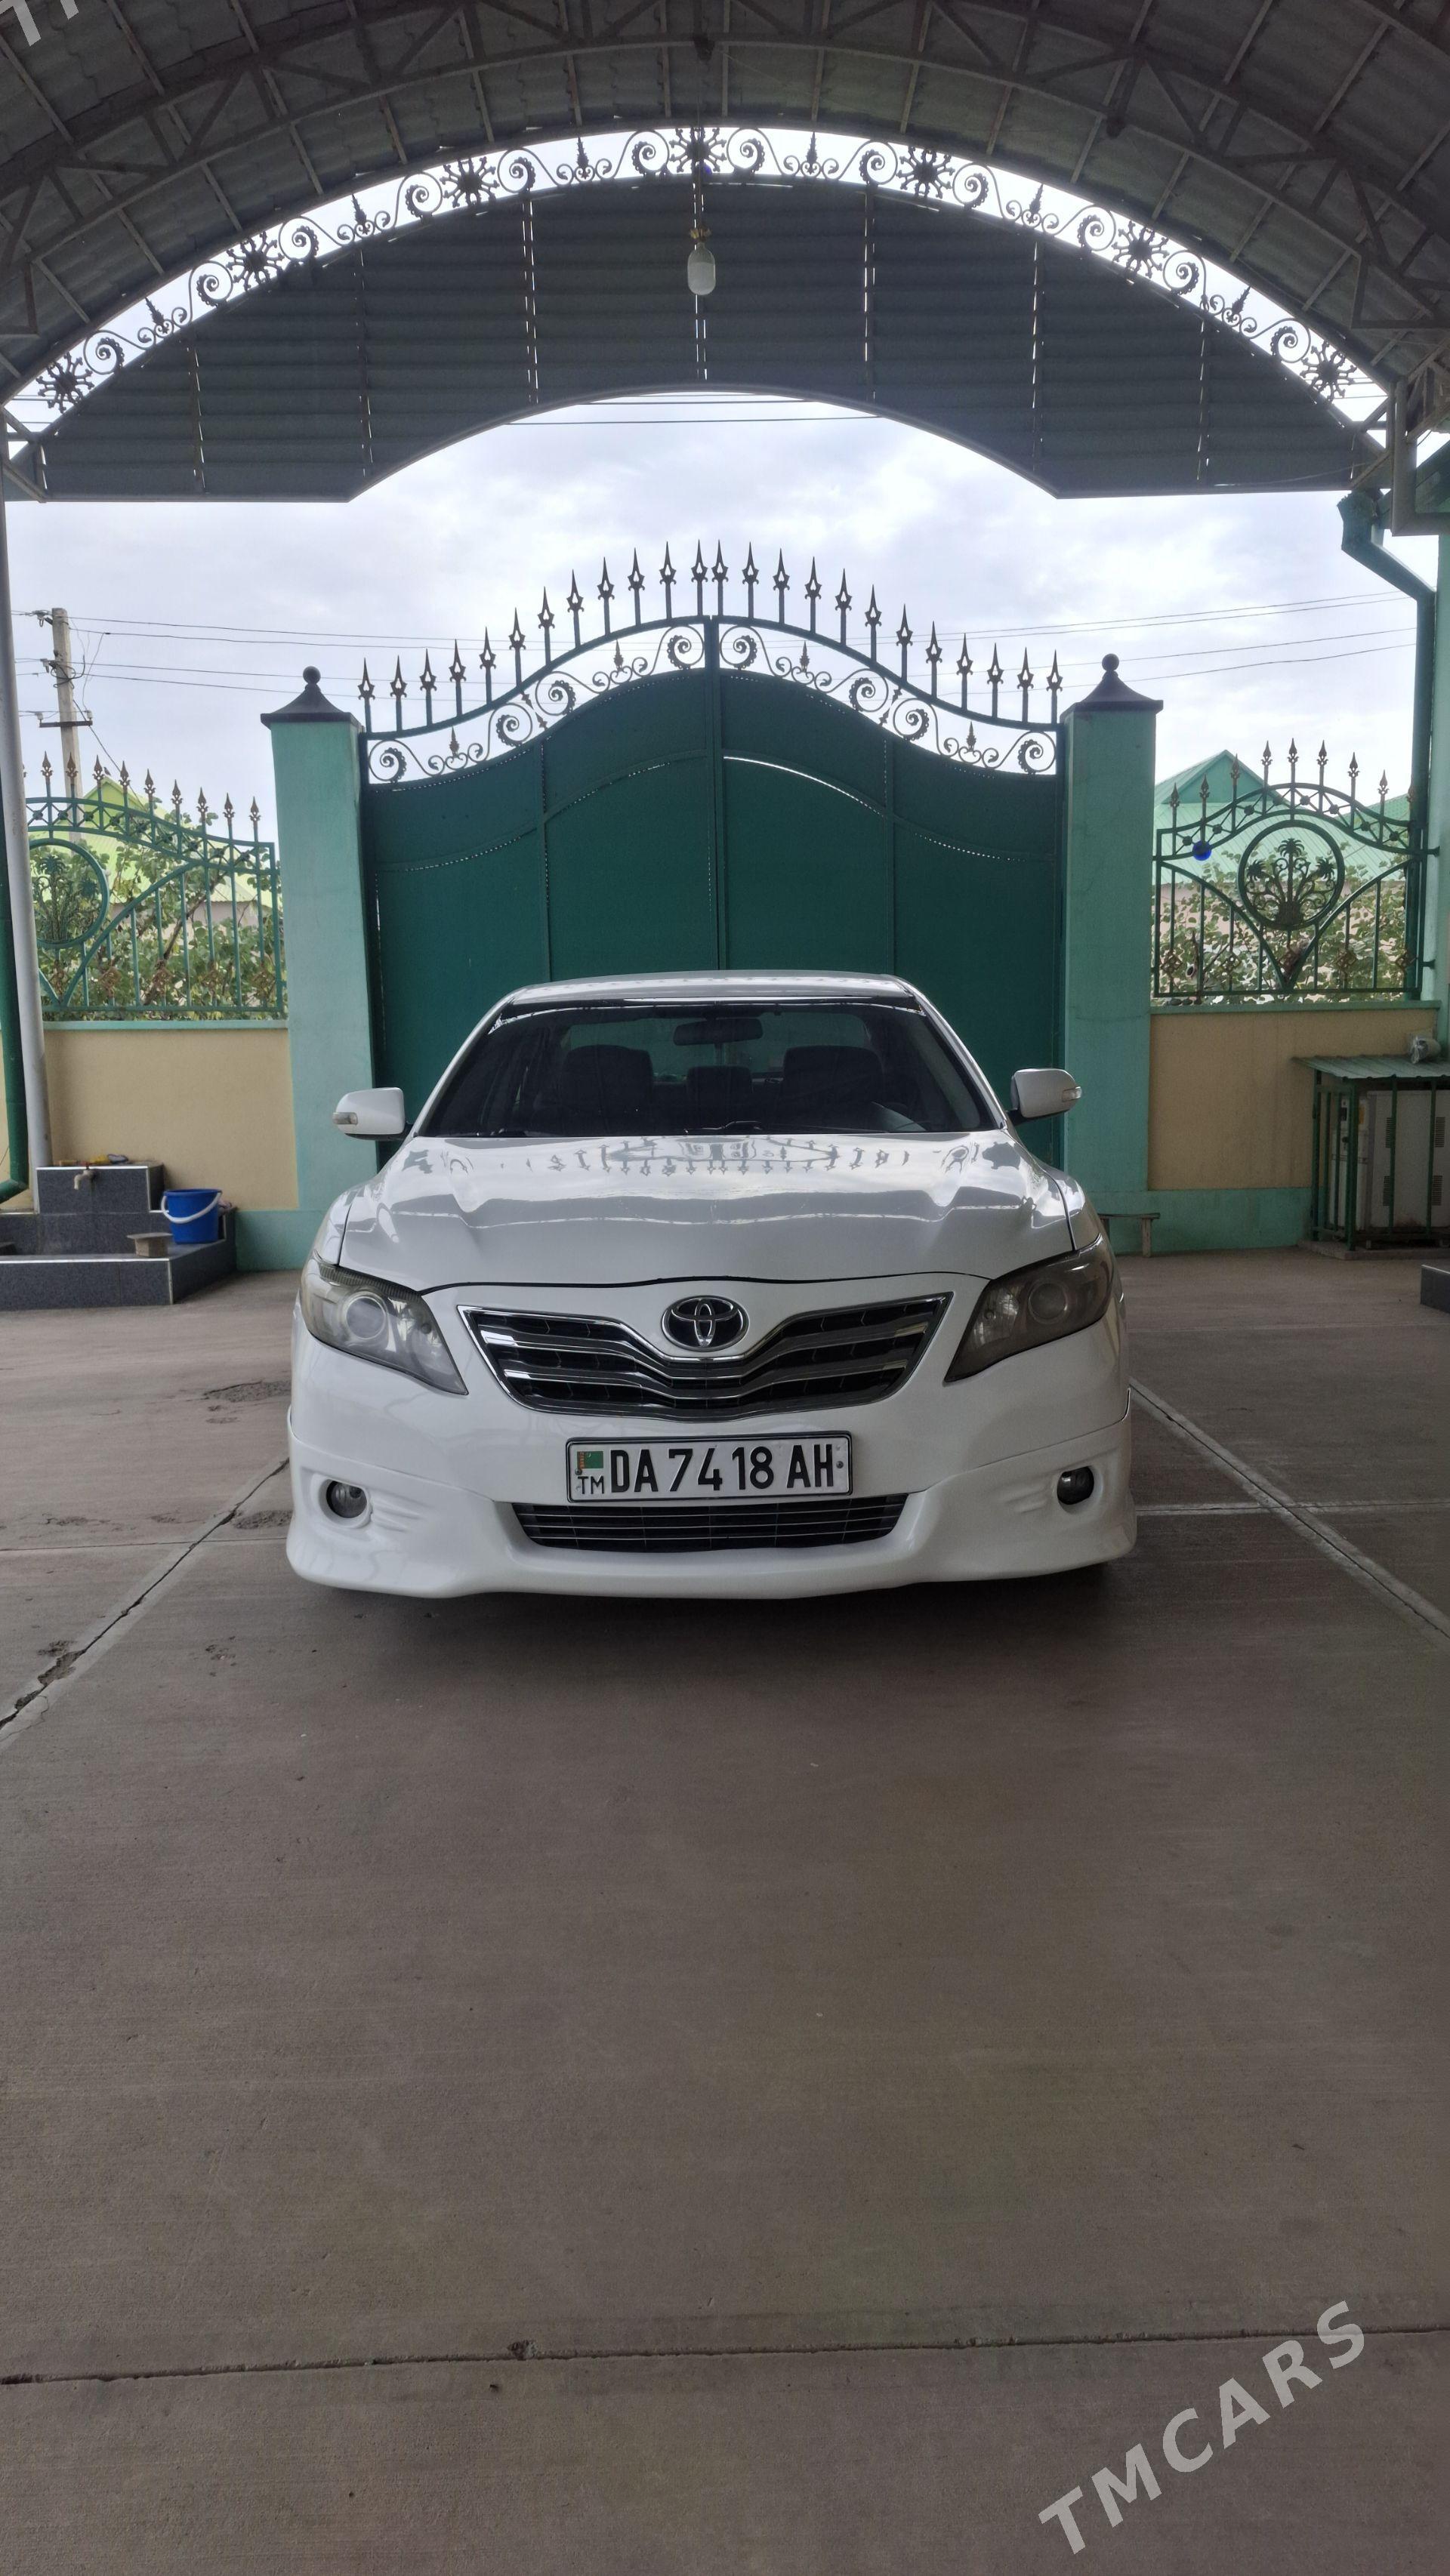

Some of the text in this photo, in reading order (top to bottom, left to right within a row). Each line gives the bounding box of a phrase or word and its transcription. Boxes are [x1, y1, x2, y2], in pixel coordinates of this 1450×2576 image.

[577, 1475, 605, 1495] TM
[610, 1444, 834, 1493] DA 7418 AH
